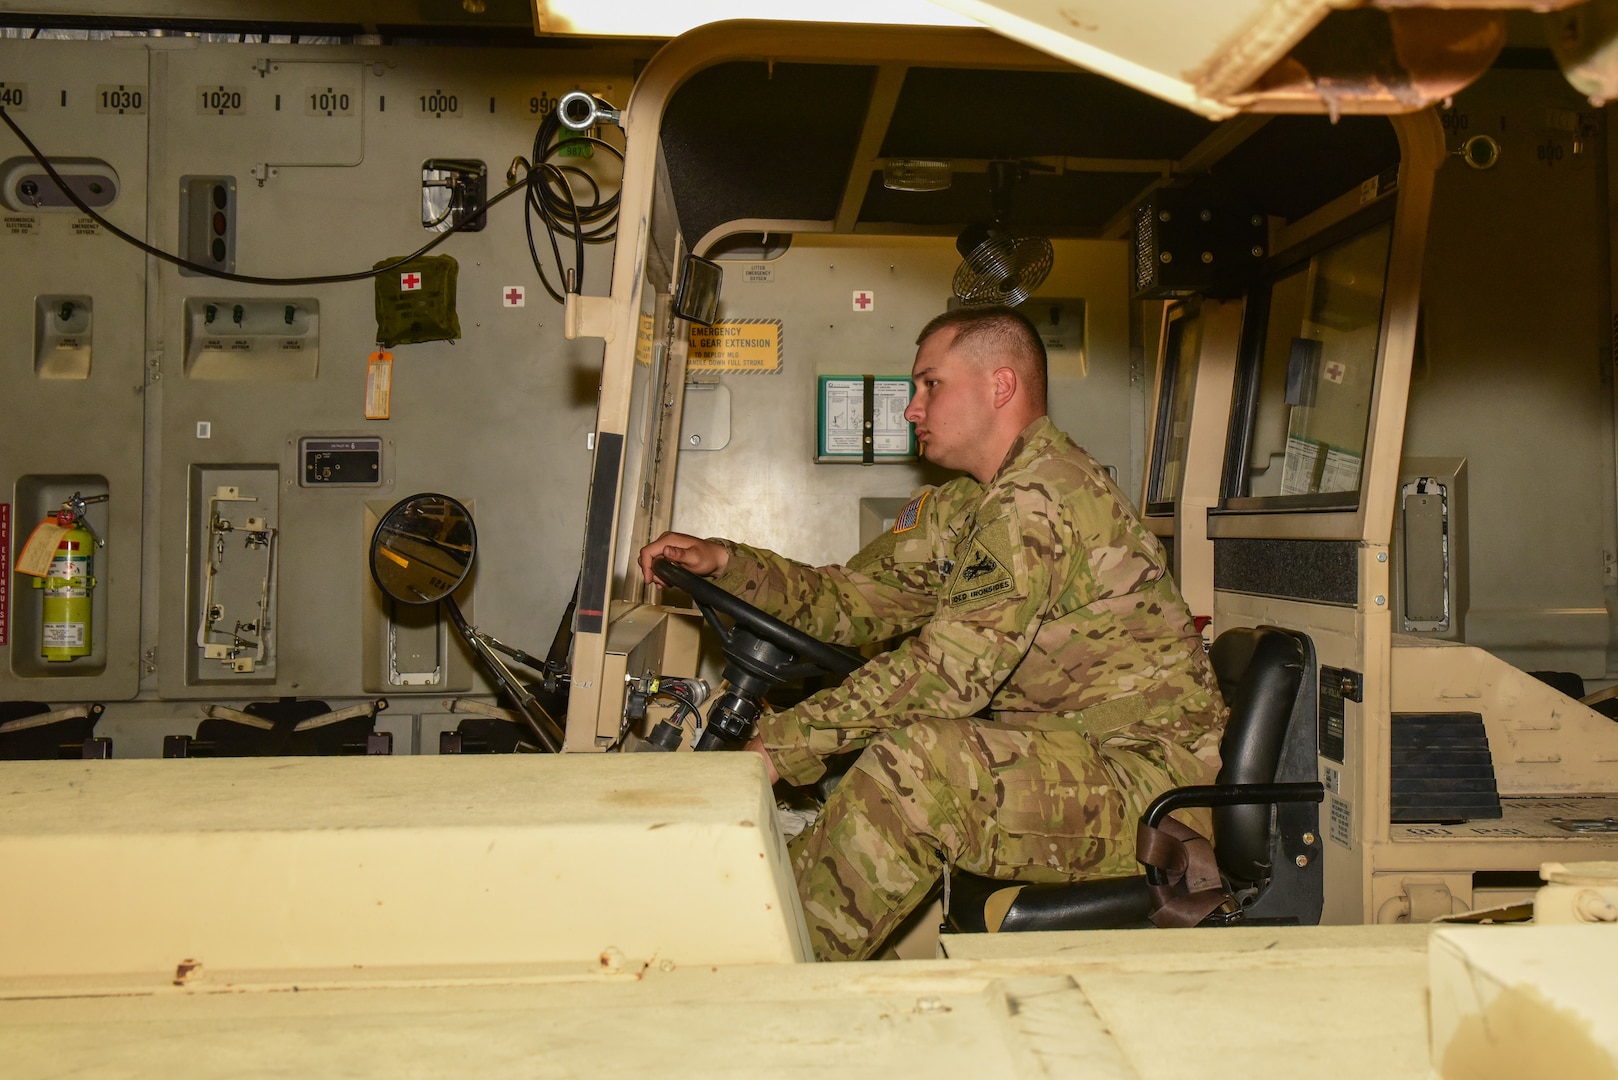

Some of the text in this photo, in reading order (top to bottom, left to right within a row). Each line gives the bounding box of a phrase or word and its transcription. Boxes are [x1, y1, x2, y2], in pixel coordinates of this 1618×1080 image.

[101, 91, 142, 109] 1030
[201, 92, 241, 110] 1020
[310, 94, 350, 111] 1010
[419, 95, 458, 113] 1000
[691, 327, 742, 337] EMERGENCY
[700, 339, 722, 348] GEAR
[725, 339, 771, 348] EXTENSION
[953, 581, 1010, 603] OLD IRONSIDES
